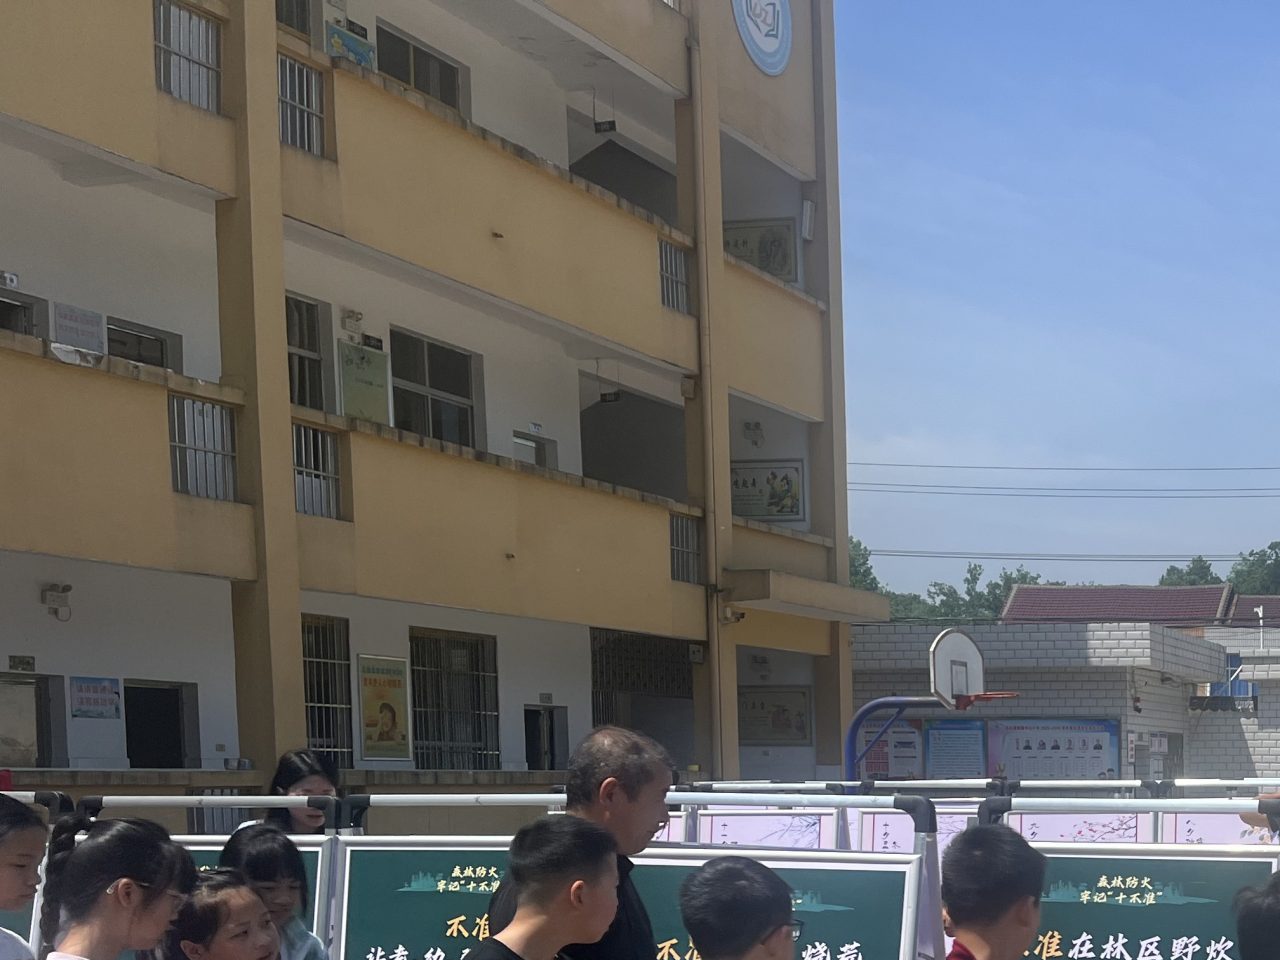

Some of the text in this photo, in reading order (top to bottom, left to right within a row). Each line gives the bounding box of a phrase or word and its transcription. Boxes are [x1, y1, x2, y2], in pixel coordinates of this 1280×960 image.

[451, 865, 499, 879] 森林防火
[1096, 875, 1153, 890] 森林防火
[446, 913, 491, 941] 不准
